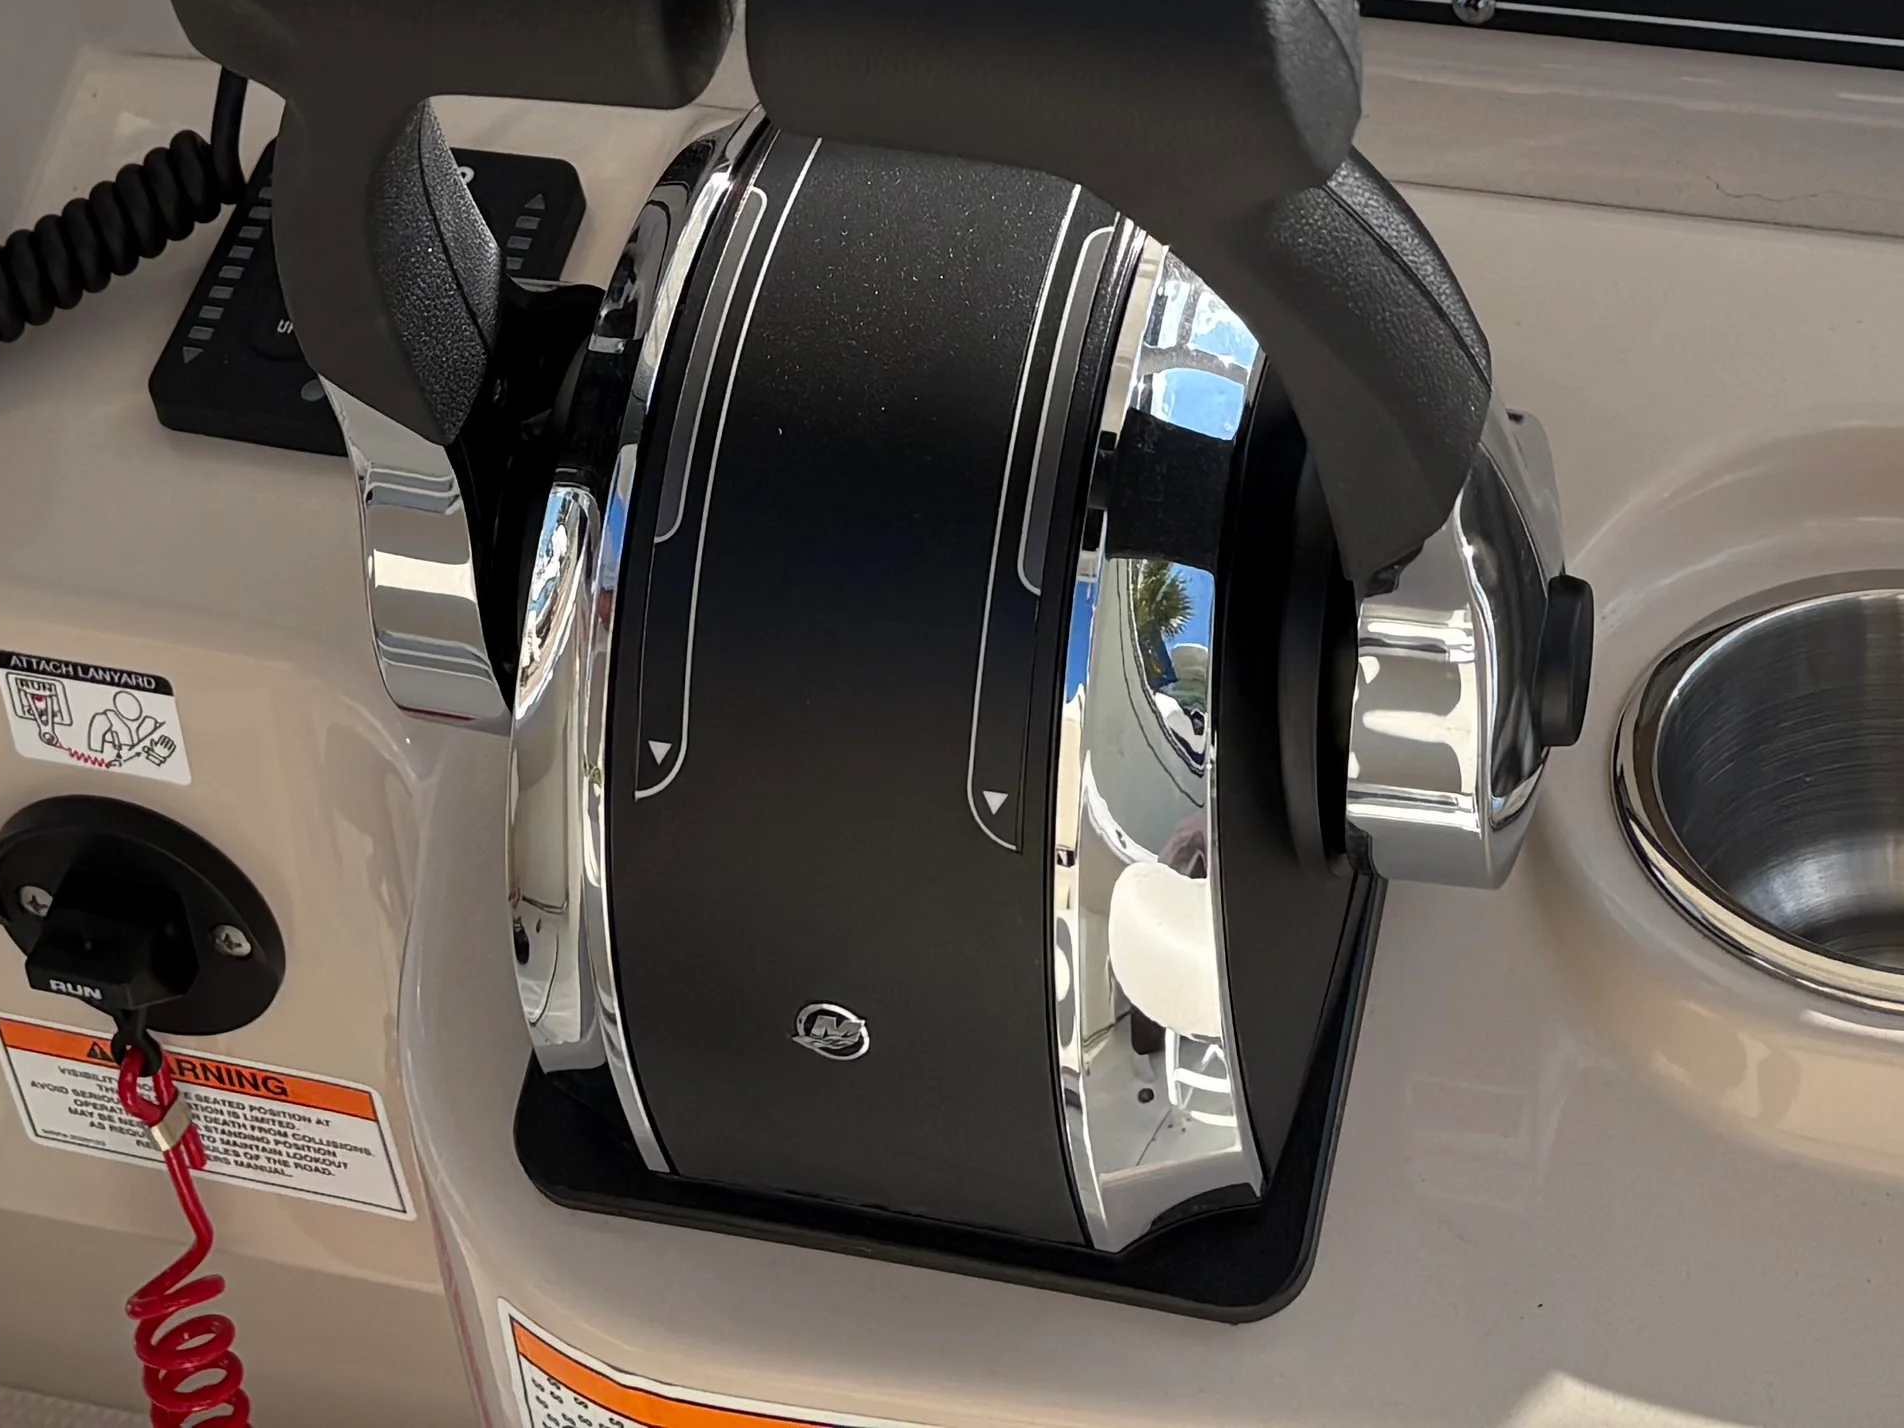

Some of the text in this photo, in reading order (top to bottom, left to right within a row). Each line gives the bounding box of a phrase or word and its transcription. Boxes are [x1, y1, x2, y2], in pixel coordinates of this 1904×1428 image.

[10, 655, 157, 690] ATTACH LANYARD
[18, 678, 53, 693] RUN
[49, 978, 103, 1002] RUN
[196, 1094, 331, 1127] SEATED POSITION AT
